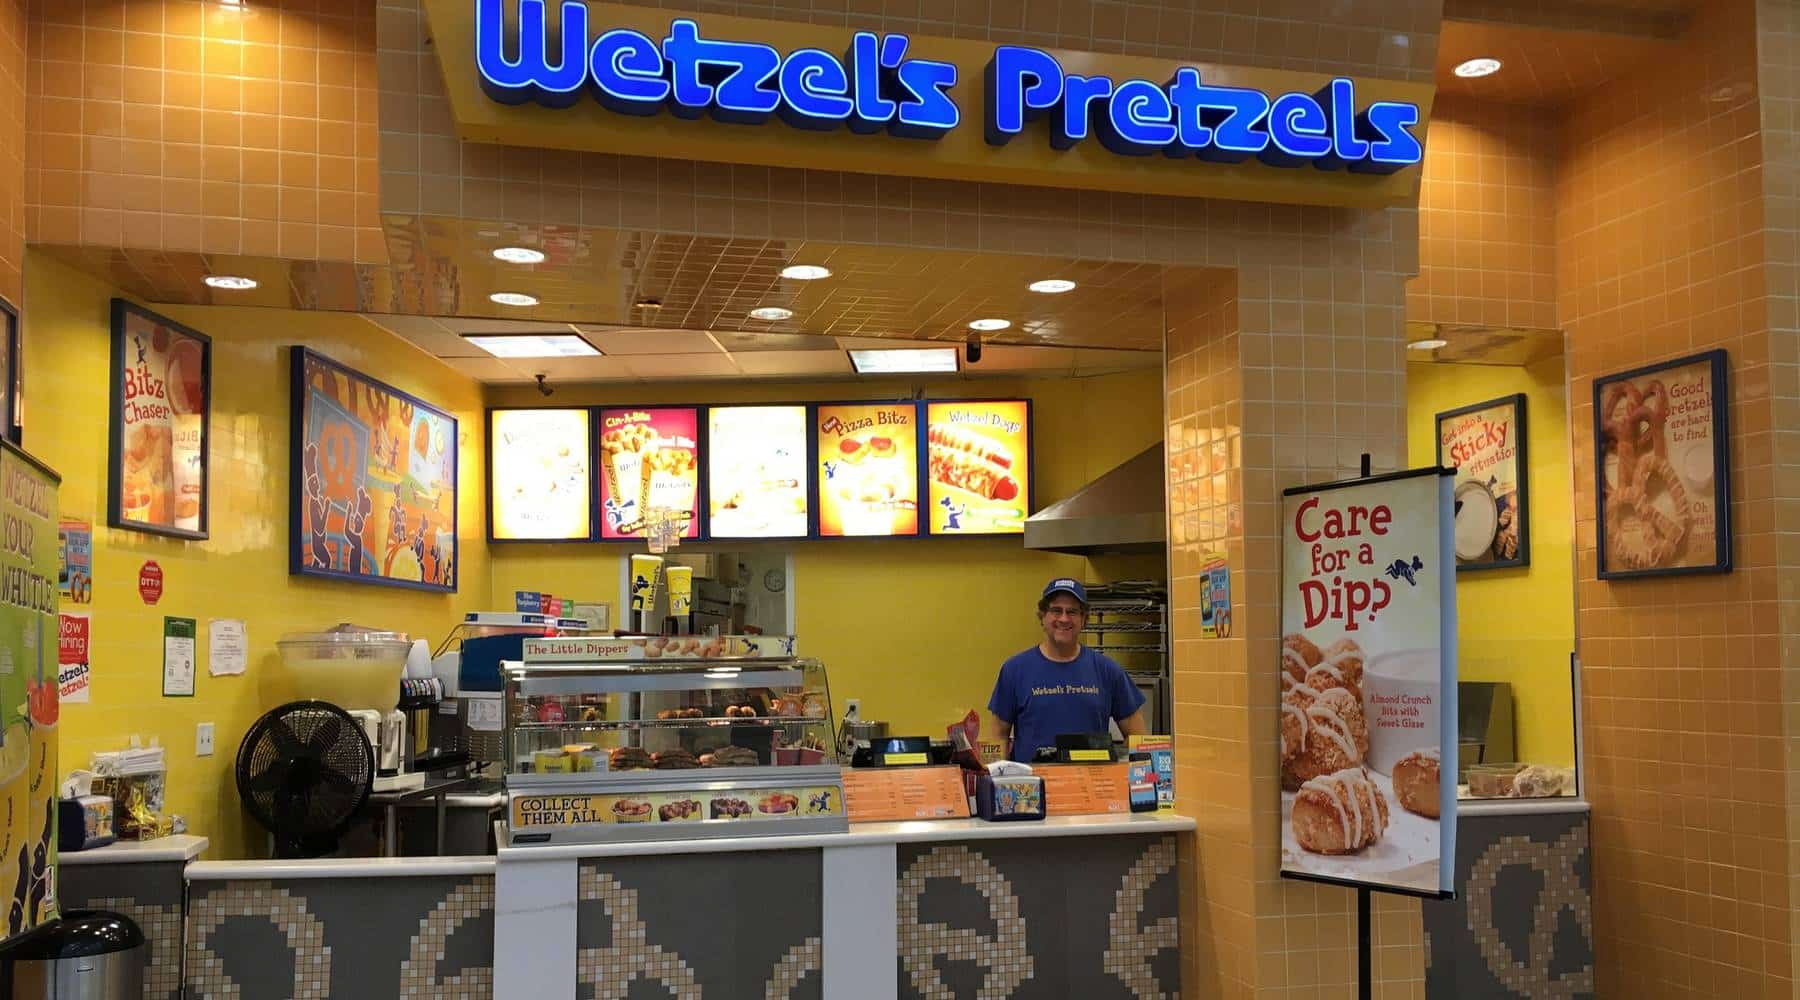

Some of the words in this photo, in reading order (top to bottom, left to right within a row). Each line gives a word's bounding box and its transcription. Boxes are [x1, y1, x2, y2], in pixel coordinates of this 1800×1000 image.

[476, 0, 960, 128] Wetzel's
[996, 46, 1422, 163] Pretzels
[125, 364, 165, 400] Bitz
[1671, 376, 1704, 398] Good
[124, 401, 170, 425] Chaser
[835, 418, 873, 437] Pizza
[877, 411, 908, 425] Bitz
[1295, 497, 1392, 542] Care
[3, 511, 35, 566] YOUR
[1311, 543, 1350, 576] for
[1358, 543, 1374, 564] a
[1299, 576, 1391, 631] Dip?
[527, 644, 547, 655] The
[551, 643, 583, 655] Little
[586, 643, 629, 656] Dippers
[1401, 693, 1432, 704] Crunch
[520, 797, 592, 812] COLLECT
[520, 812, 566, 825] THEM
[571, 810, 601, 824] ALL
